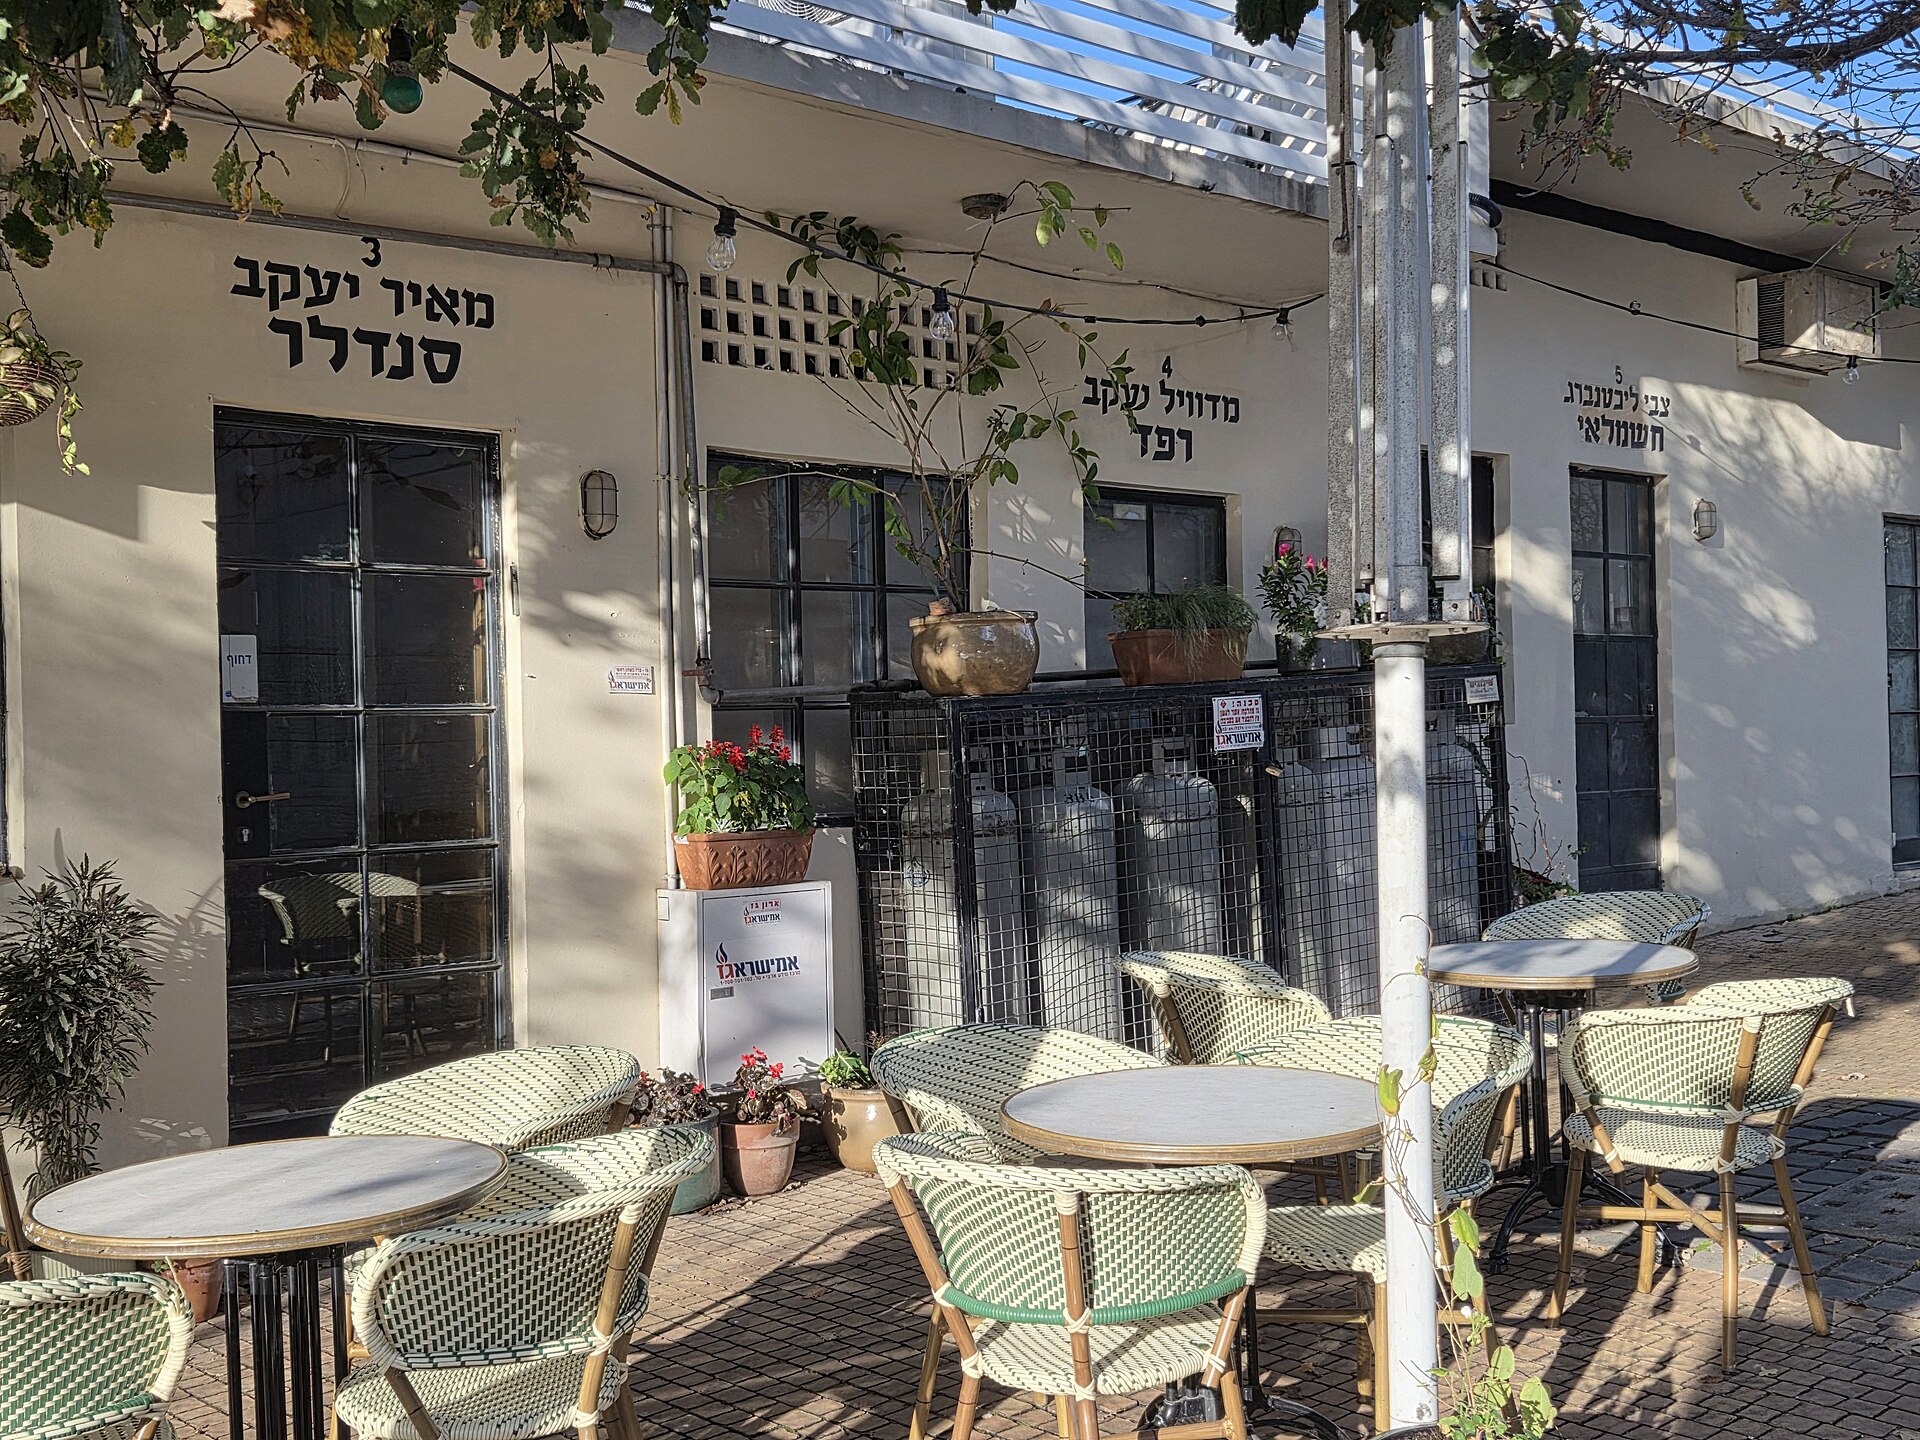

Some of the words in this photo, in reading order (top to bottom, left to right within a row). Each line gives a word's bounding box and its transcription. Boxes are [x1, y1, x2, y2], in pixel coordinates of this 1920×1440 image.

[361, 236, 382, 267] 3
[229, 255, 360, 313] יעקב
[379, 276, 495, 329] מאיר
[267, 314, 462, 384] סנדלר
[1161, 355, 1173, 379] 4
[1614, 365, 1623, 384] 5
[1158, 378, 1240, 424] מדוויל
[1563, 381, 1639, 413] ליכטנברג
[1644, 393, 1671, 417] צבי
[1133, 423, 1193, 463] רפד
[1577, 413, 1664, 452] חשמלאי
[226, 654, 252, 668] דחוף
[609, 681, 650, 690] אמישראגז
[1216, 732, 1262, 746] אמישראגז
[761, 900, 780, 910] ארון
[743, 913, 781, 924] אמישראגז
[716, 956, 800, 980] אמישראגז
